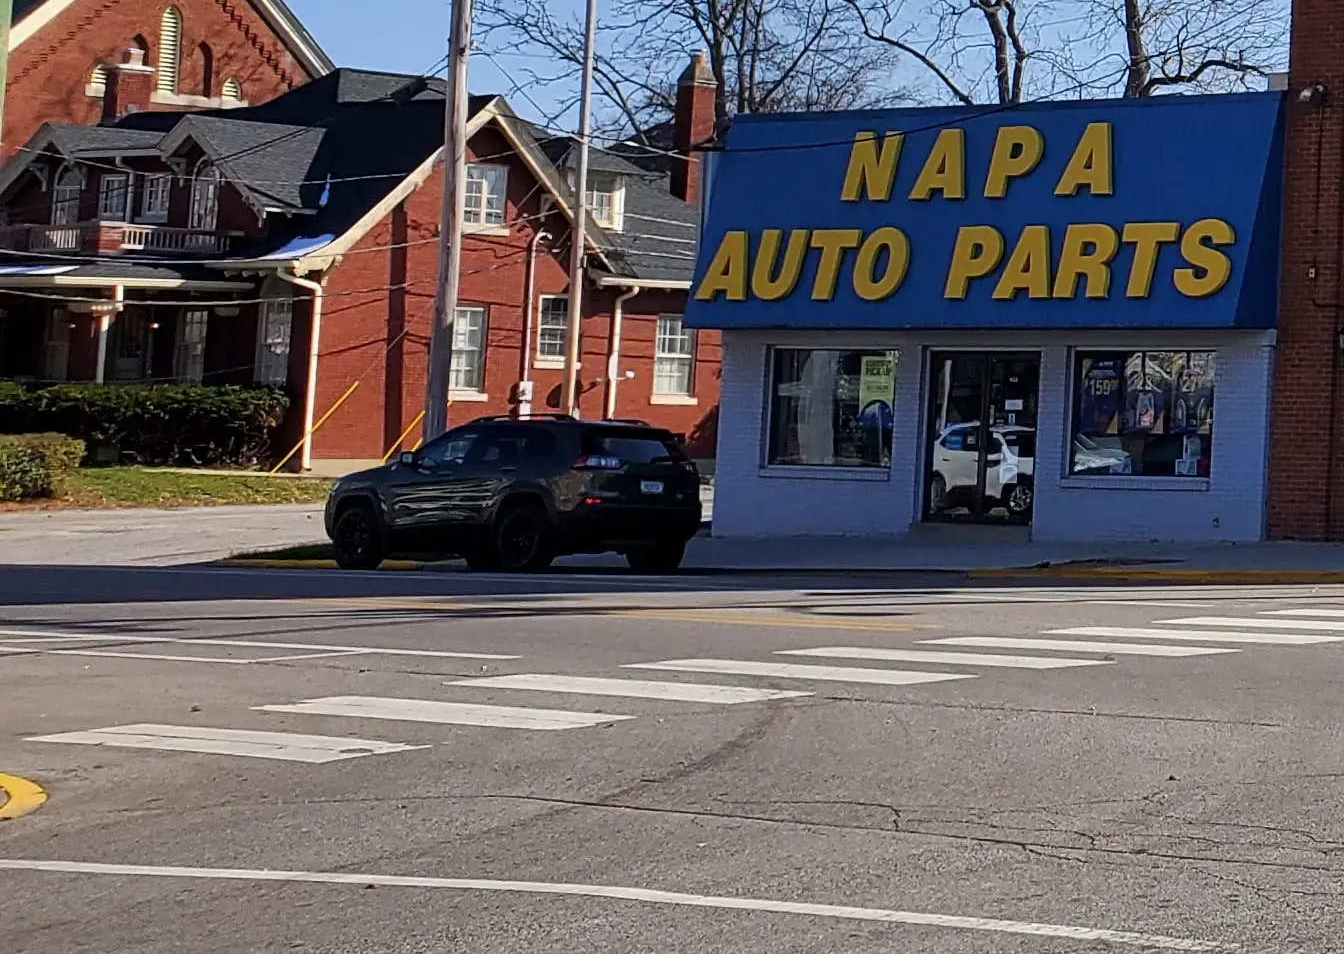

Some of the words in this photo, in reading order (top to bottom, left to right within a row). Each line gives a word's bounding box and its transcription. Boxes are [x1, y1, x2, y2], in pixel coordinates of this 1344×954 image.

[840, 122, 1114, 202] NAPA
[694, 226, 911, 302] AUTO
[944, 218, 1236, 300] PARTS
